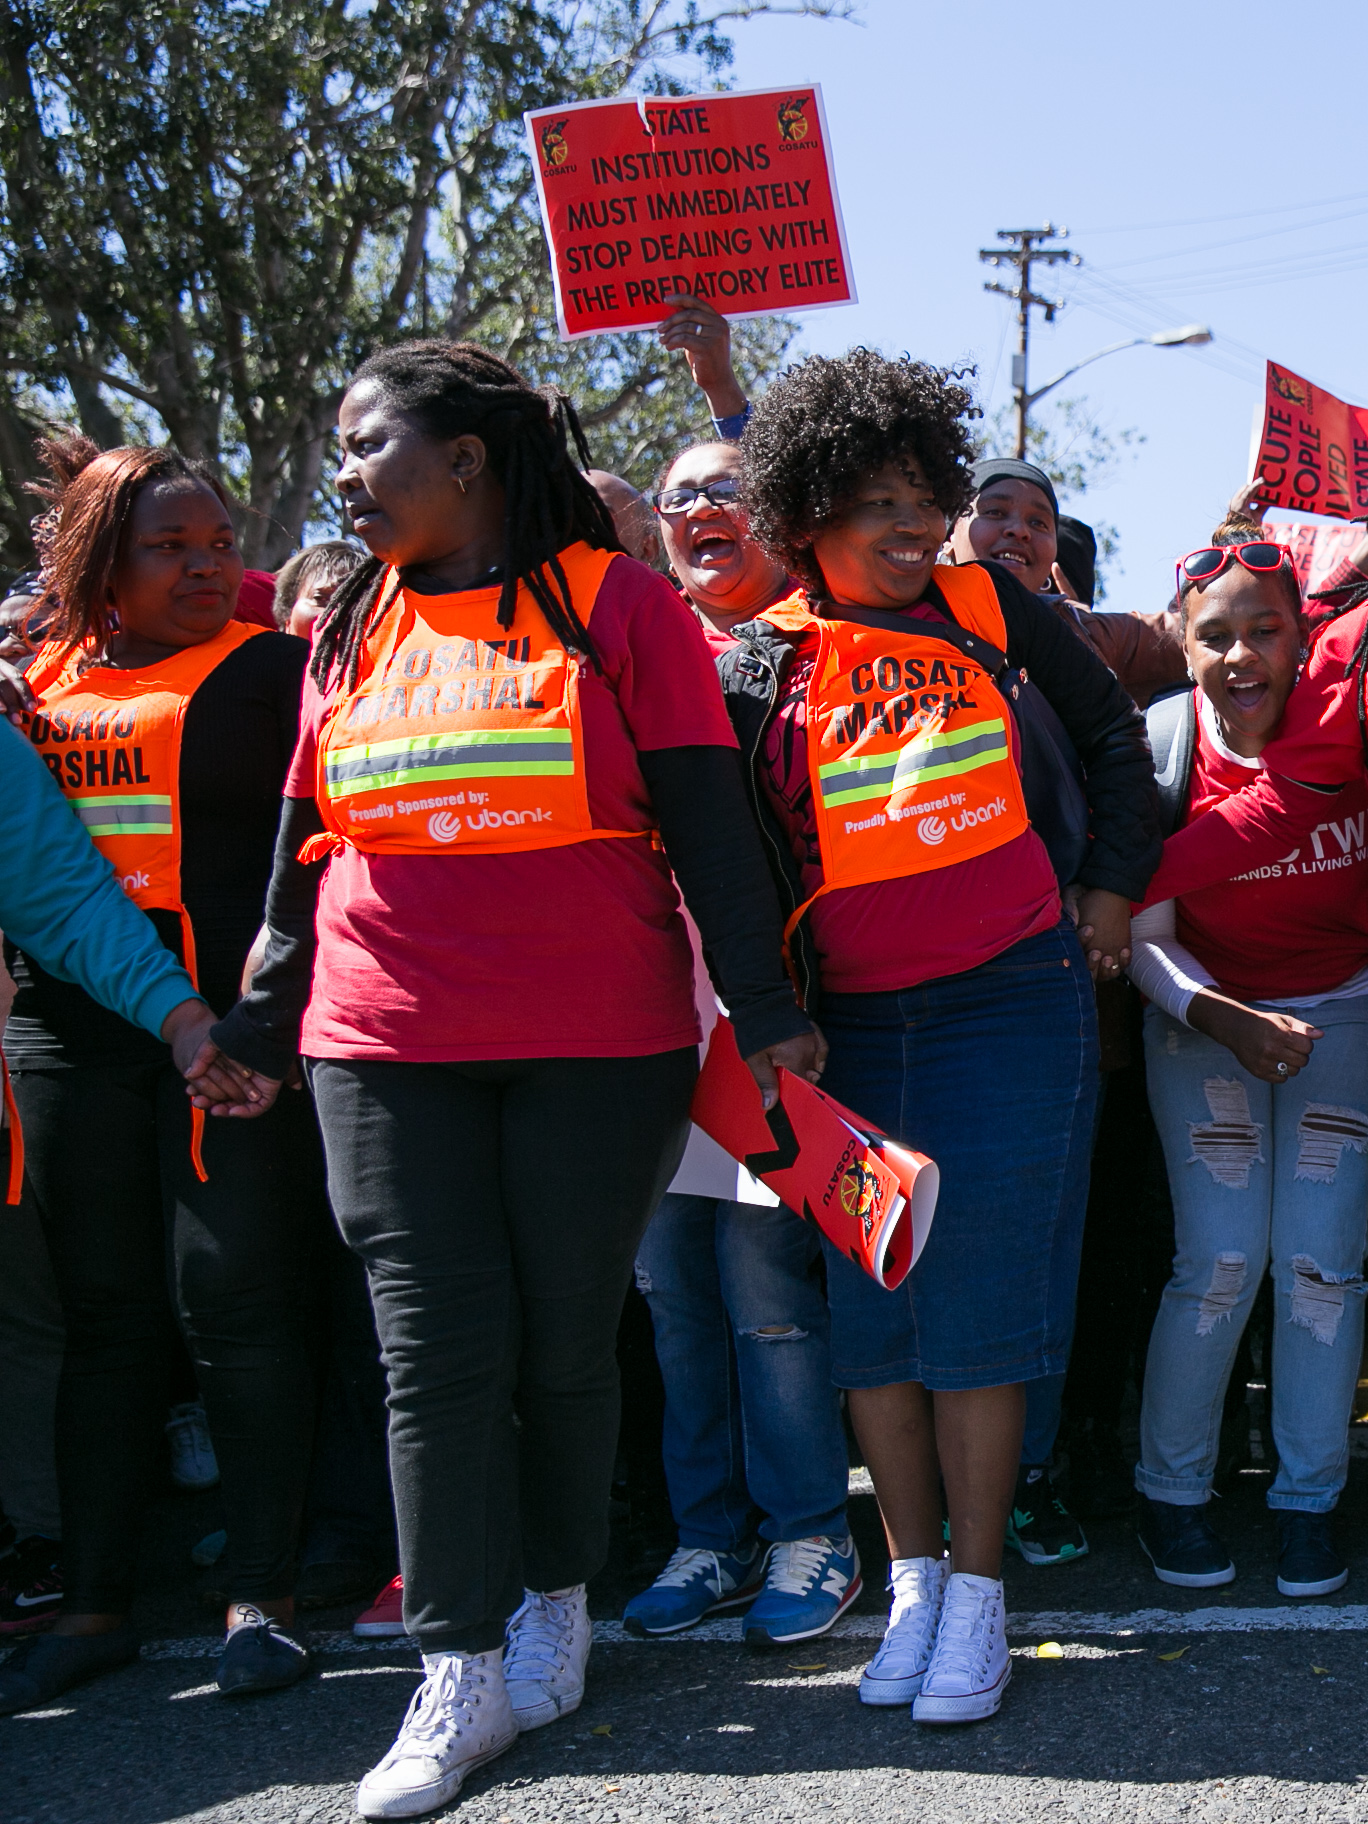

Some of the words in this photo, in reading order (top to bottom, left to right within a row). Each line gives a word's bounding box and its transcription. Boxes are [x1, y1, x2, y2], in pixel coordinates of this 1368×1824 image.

[642, 107, 710, 137] STATE
[590, 143, 771, 186] INSTITUTIONS
[778, 140, 819, 153] COSATU
[543, 163, 577, 179] COSATU
[567, 195, 638, 232] MUST
[646, 179, 812, 222] IMMEDIATELY
[565, 240, 632, 275] STOP
[640, 227, 752, 264] DEALING
[758, 218, 830, 250] WITH
[568, 284, 620, 315] THE
[625, 266, 770, 308] PREDATORY
[779, 258, 840, 291] ELITE
[1325, 443, 1350, 519] LVED
[383, 635, 531, 683] COSATU
[851, 656, 981, 696] COSAT
[349, 673, 544, 728] MARSHAL
[836, 690, 978, 744] MARSHL
[42, 747, 150, 789] RSHAL
[348, 801, 395, 823] Proudly
[397, 792, 466, 817] Sponsored
[468, 790, 490, 806] by:
[466, 807, 553, 831] ubank
[844, 812, 886, 835] Proudly
[888, 795, 949, 822] Sponsored
[951, 792, 967, 807] by:
[951, 796, 1008, 832] ubank
[1286, 863, 1298, 876] A
[1302, 854, 1352, 874] LIVING
[822, 1138, 857, 1207] COSATU
